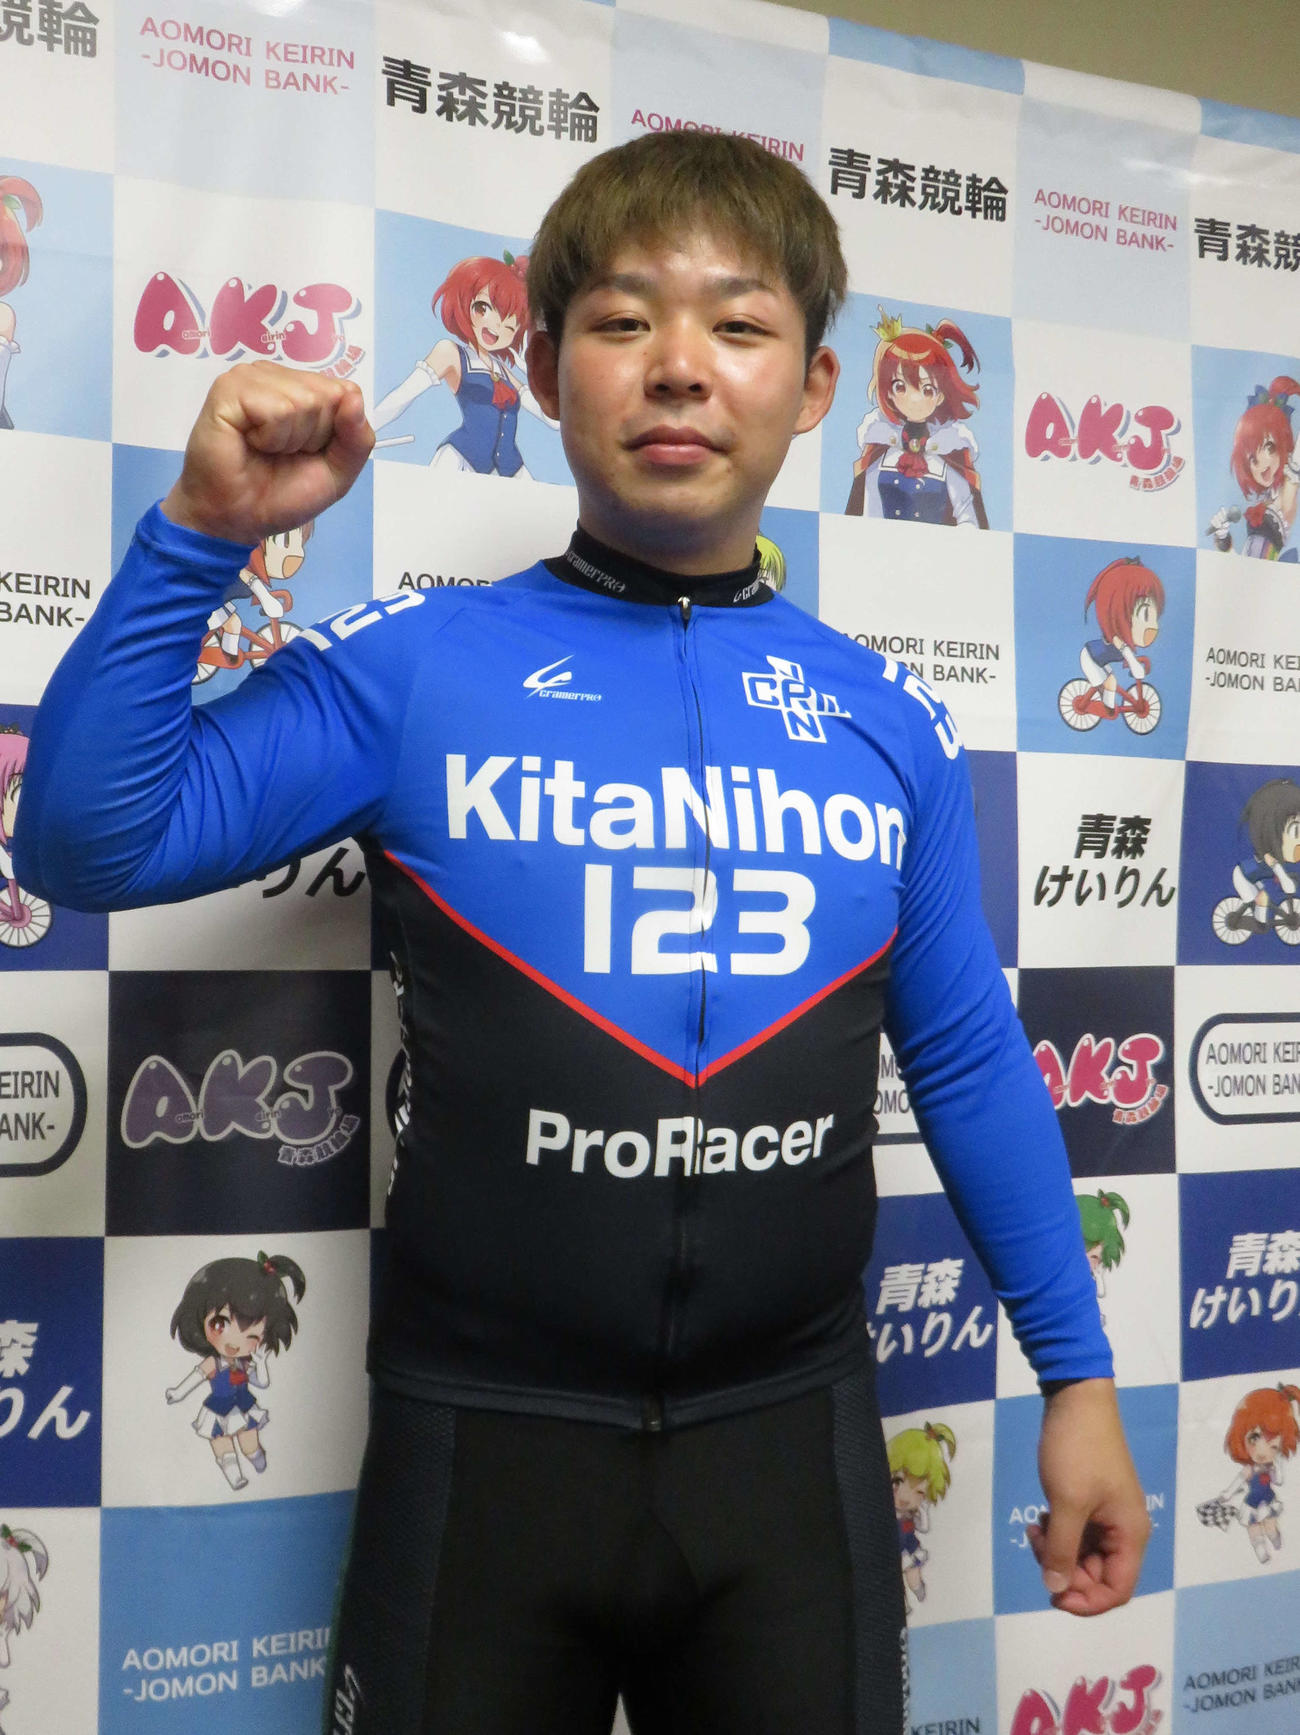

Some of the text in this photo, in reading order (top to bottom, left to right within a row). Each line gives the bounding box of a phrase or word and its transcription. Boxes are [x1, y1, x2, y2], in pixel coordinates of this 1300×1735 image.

[140, 17, 354, 70] AOMORI KEIRIN
[141, 48, 350, 95] -JOMON BANK-
[381, 56, 600, 143] 青森競輪
[829, 146, 1009, 222] 青森競輪
[1034, 189, 1178, 231] AOMORI KEIRIN
[1035, 215, 1175, 252] -JOMON BANK-
[133, 271, 358, 363] AKJ
[1025, 391, 1177, 471] AKJ
[844, 633, 1000, 660] OMORI KEIRIN
[1206, 647, 1266, 668] AOMORI
[933, 664, 996, 684] BANK-
[1205, 672, 1264, 691] -JOMON
[446, 753, 907, 870] KitaNihon
[1074, 813, 1152, 860] 青森
[1034, 865, 1176, 909] けいりん
[583, 863, 817, 976] 123
[1206, 1042, 1267, 1065] AOMORI
[121, 1049, 353, 1149] AKJ
[1208, 1074, 1266, 1097] -JOMON
[525, 1108, 834, 1178] ProRacer
[1226, 1230, 1300, 1279] 青森
[875, 1258, 964, 1315] 青森
[1189, 1279, 1300, 1330] けいり
[122, 1640, 239, 1672] AOMORI
[1184, 1665, 1257, 1692] AOMORI
[123, 1670, 238, 1702] -JOMON
[1184, 1686, 1256, 1712] -JOMON
